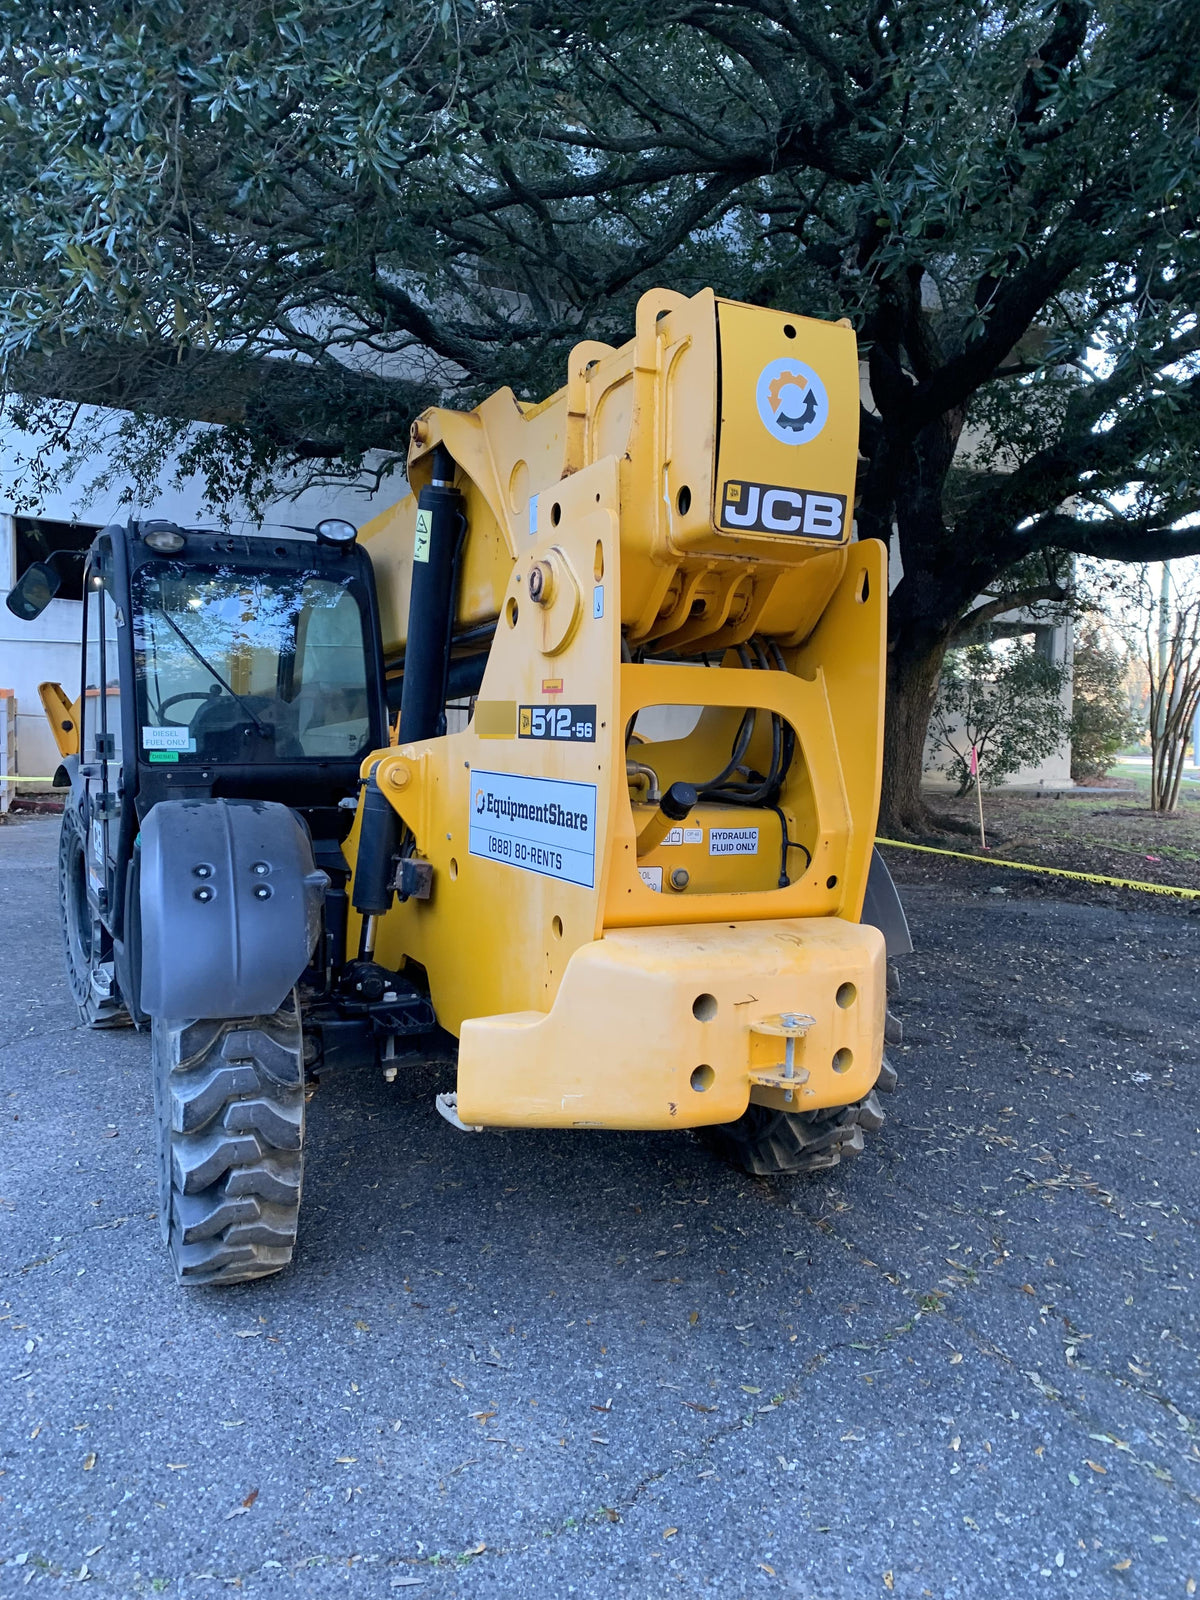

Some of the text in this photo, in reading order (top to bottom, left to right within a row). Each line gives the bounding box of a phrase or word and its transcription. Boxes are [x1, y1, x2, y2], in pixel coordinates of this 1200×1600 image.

[724, 486, 843, 536] JCB
[531, 708, 593, 738] 512-56
[486, 792, 588, 832] EquipmentShare
[711, 831, 757, 841] HYDRAULIC
[711, 843, 757, 852] FLUID ONLY
[488, 835, 562, 871] (888) 80-RENTS
